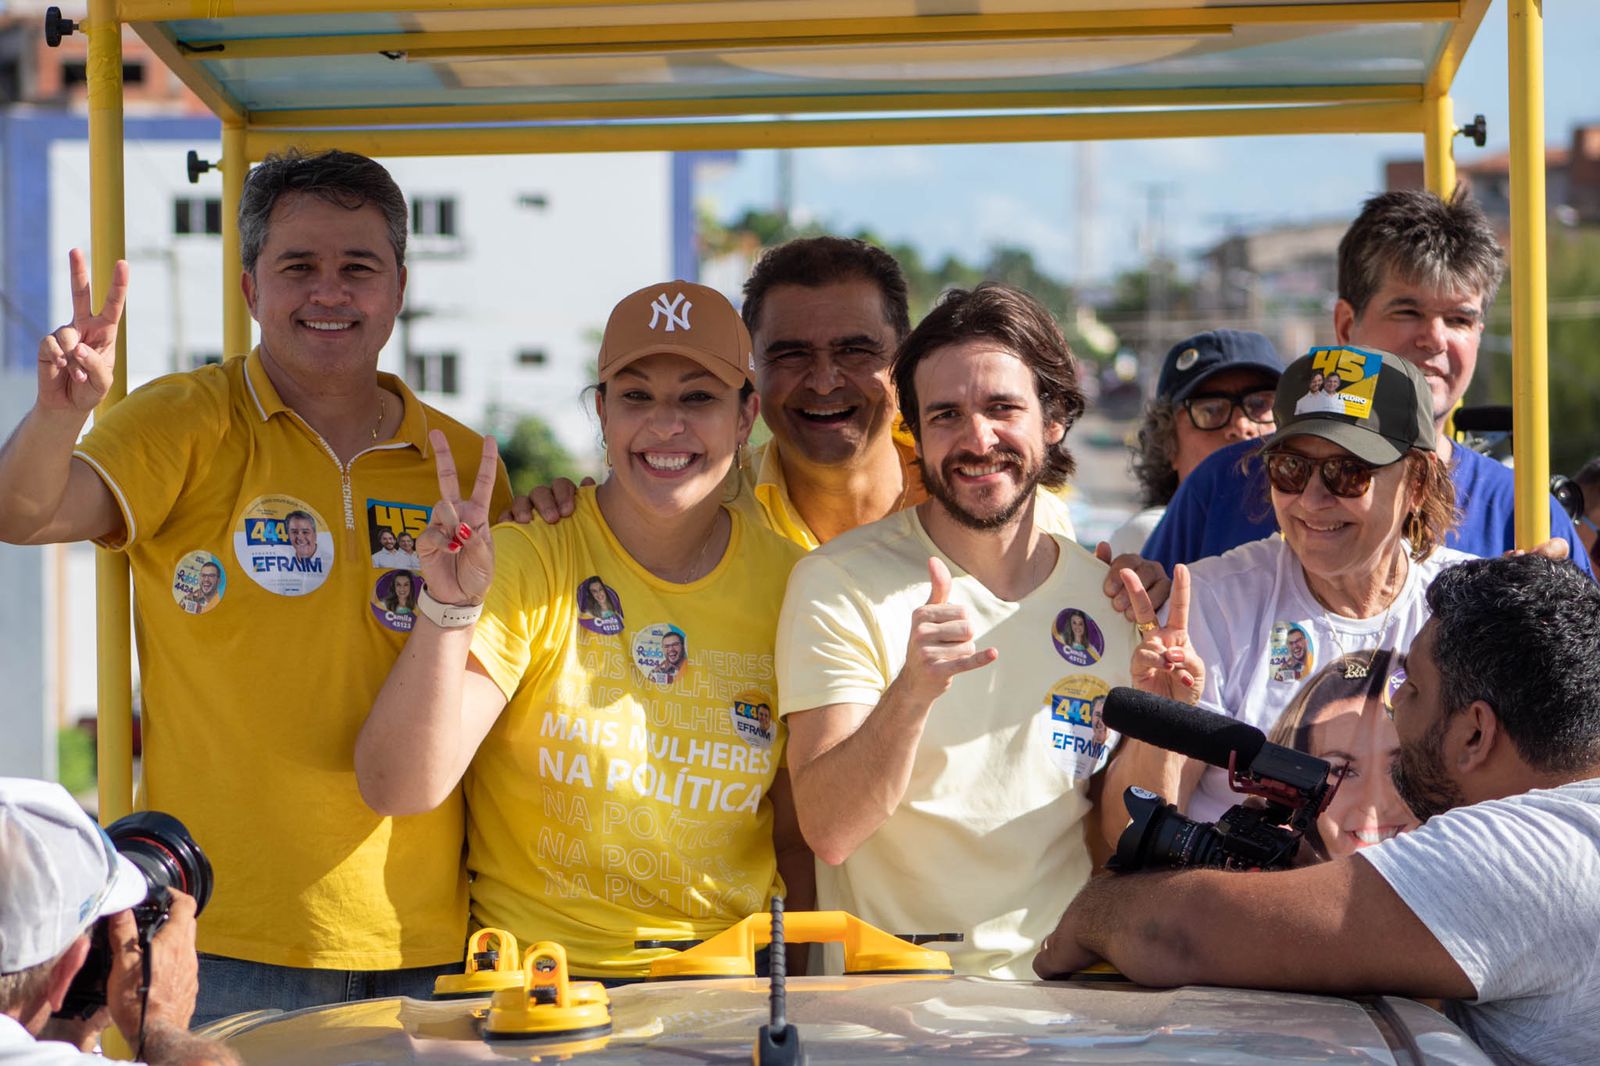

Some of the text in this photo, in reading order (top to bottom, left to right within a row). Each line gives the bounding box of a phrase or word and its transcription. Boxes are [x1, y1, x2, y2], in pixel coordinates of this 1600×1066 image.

[648, 292, 693, 331] NY
[1311, 349, 1367, 382] 45
[251, 521, 289, 542] 444
[374, 505, 429, 539] 45
[252, 556, 323, 573] EFRAIM
[737, 703, 758, 719] 444
[1055, 698, 1092, 724] 444
[540, 712, 772, 775] MAIS MULHERES
[737, 721, 771, 741] EFRAIM
[1053, 732, 1107, 761] EFRAIM
[538, 746, 763, 815] NA POLÍTICA
[542, 785, 592, 832] NA
[537, 826, 591, 868] NA
